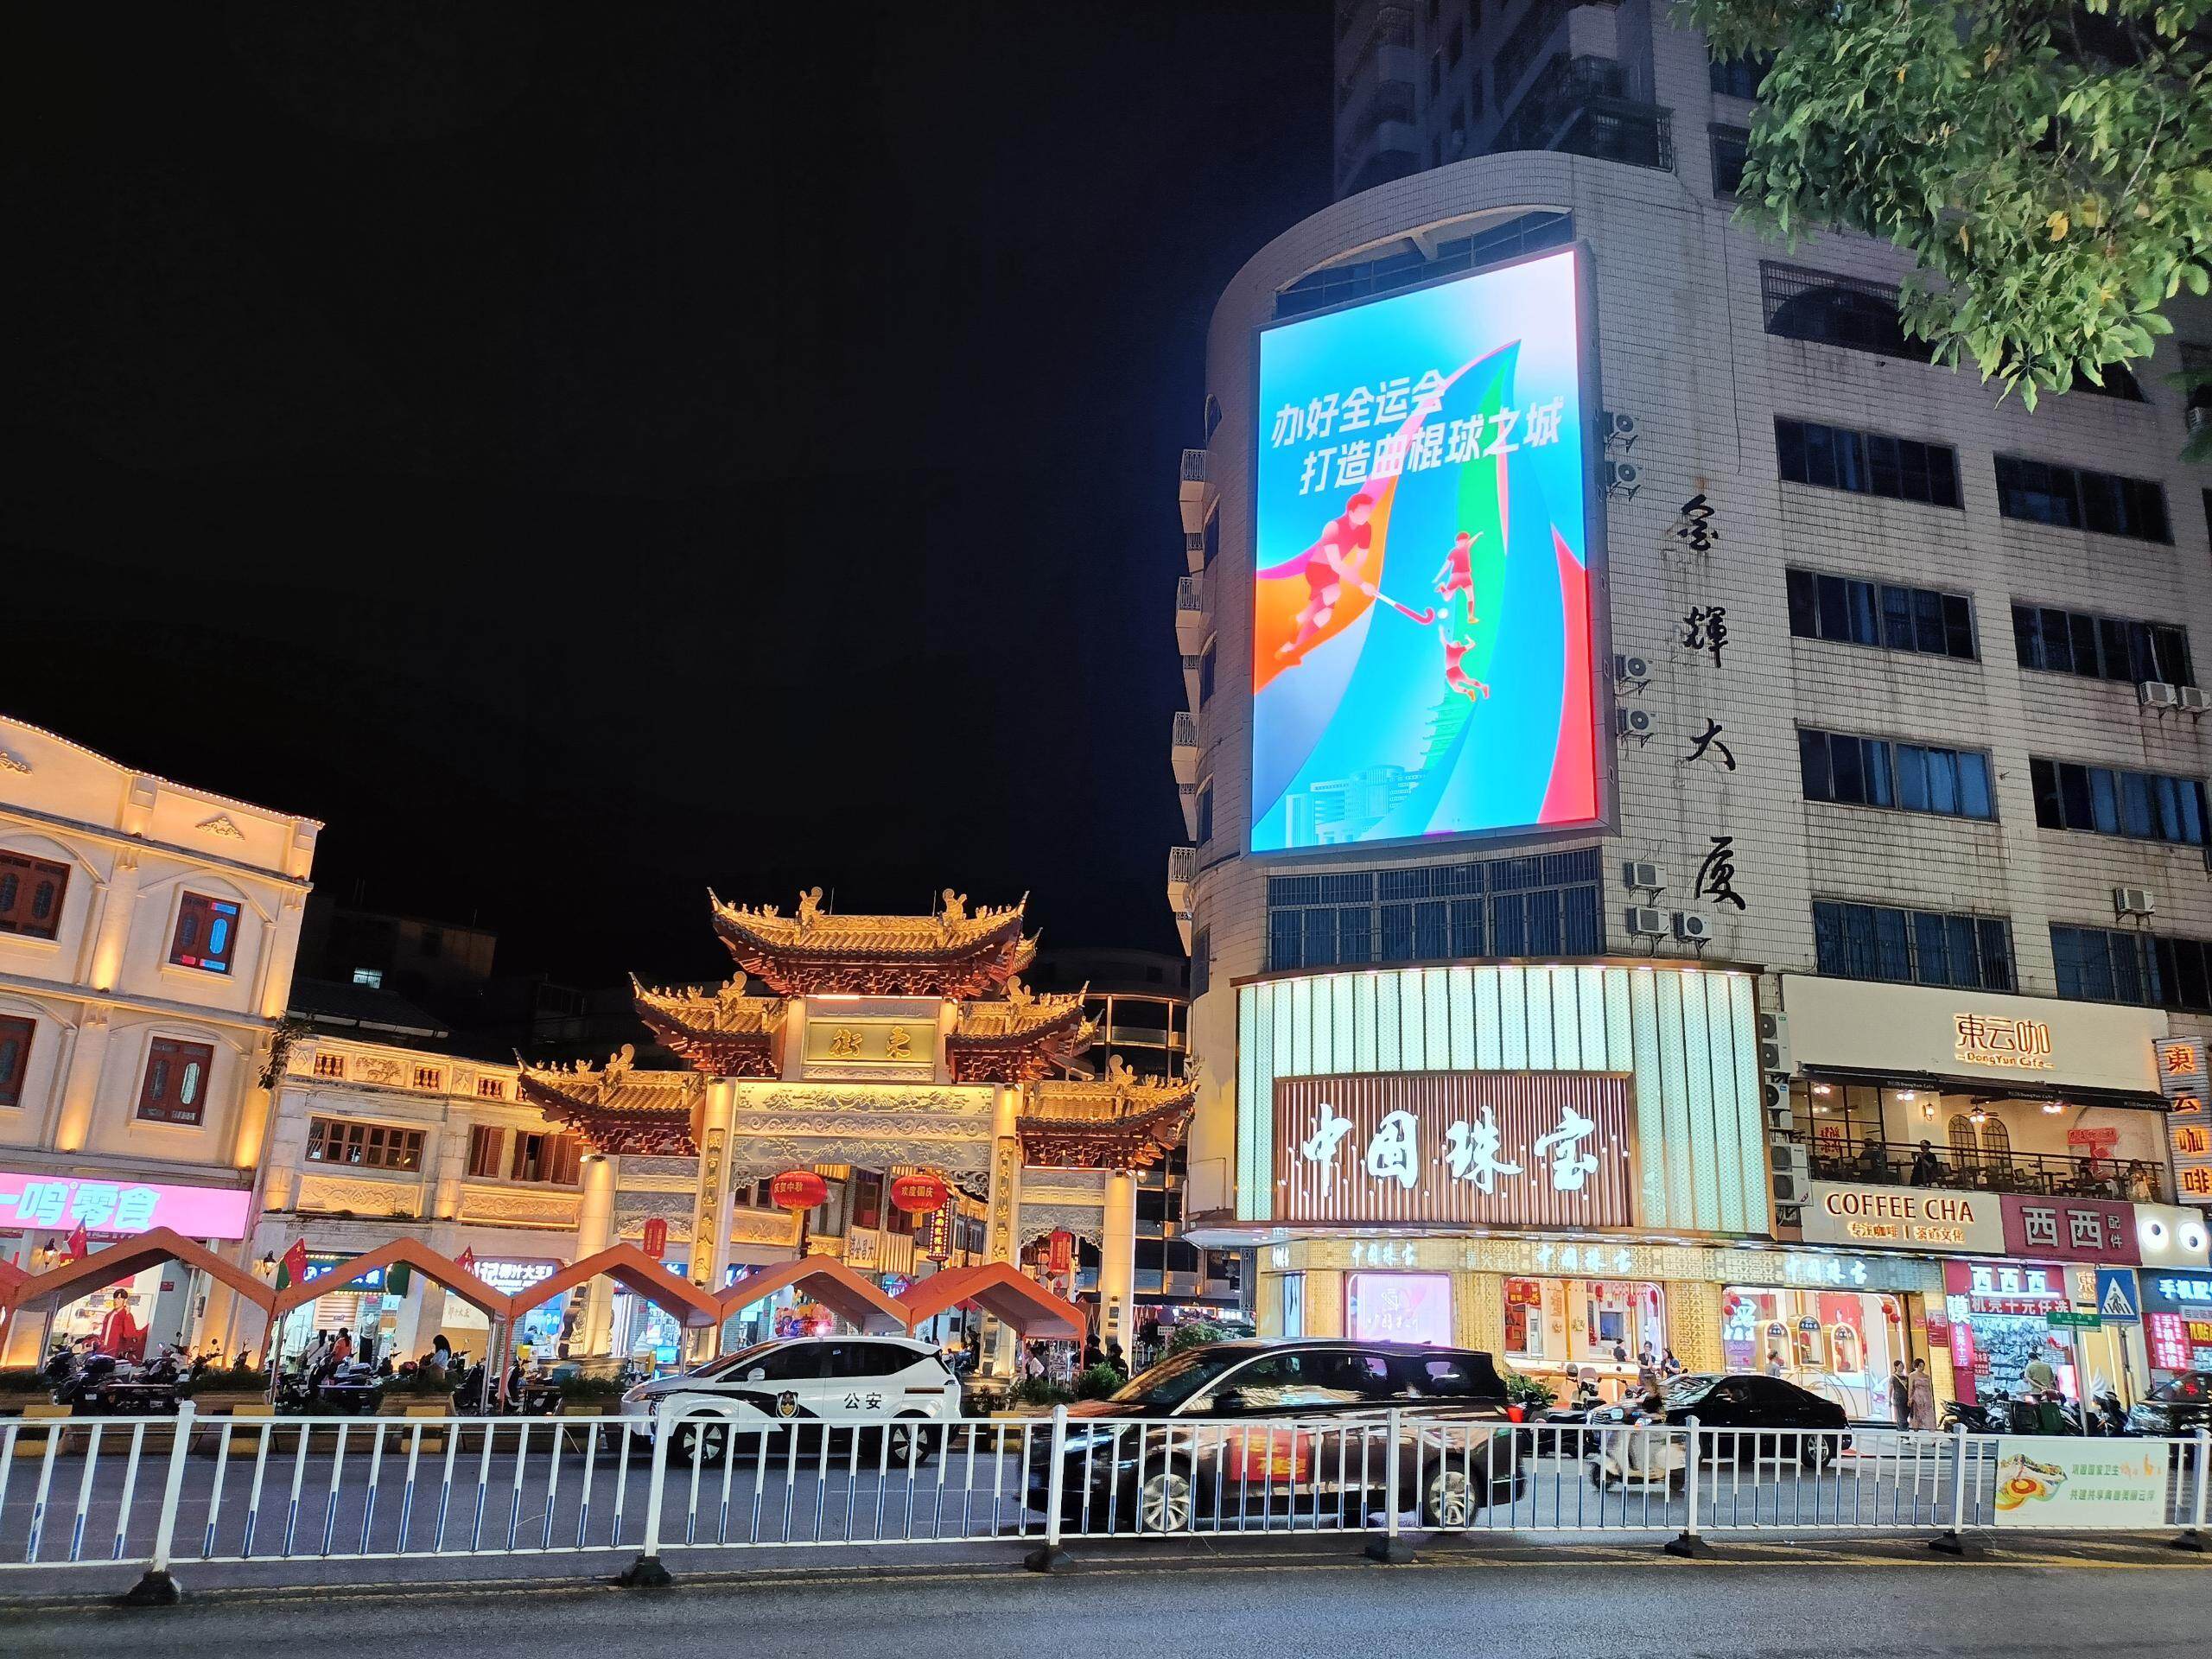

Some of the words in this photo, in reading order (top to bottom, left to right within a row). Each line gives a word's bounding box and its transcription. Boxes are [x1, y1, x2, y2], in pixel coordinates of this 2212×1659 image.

[1272, 369, 1447, 448] 办好全运会
[1299, 395, 1564, 496] 打造曲棍球之城
[1302, 1103, 1599, 1198] 中国珠宝
[901, 1185, 934, 1198] 欢度国庆
[1826, 1193, 1916, 1218] COFFEE
[1923, 1198, 1974, 1223] CHA
[2021, 1206, 2102, 1249] 西西
[2107, 1214, 2122, 1249] 配件
[1970, 1266, 2046, 1293] 西西西
[2159, 1279, 2212, 1300] 手机配
[844, 1392, 881, 1409] 公安
